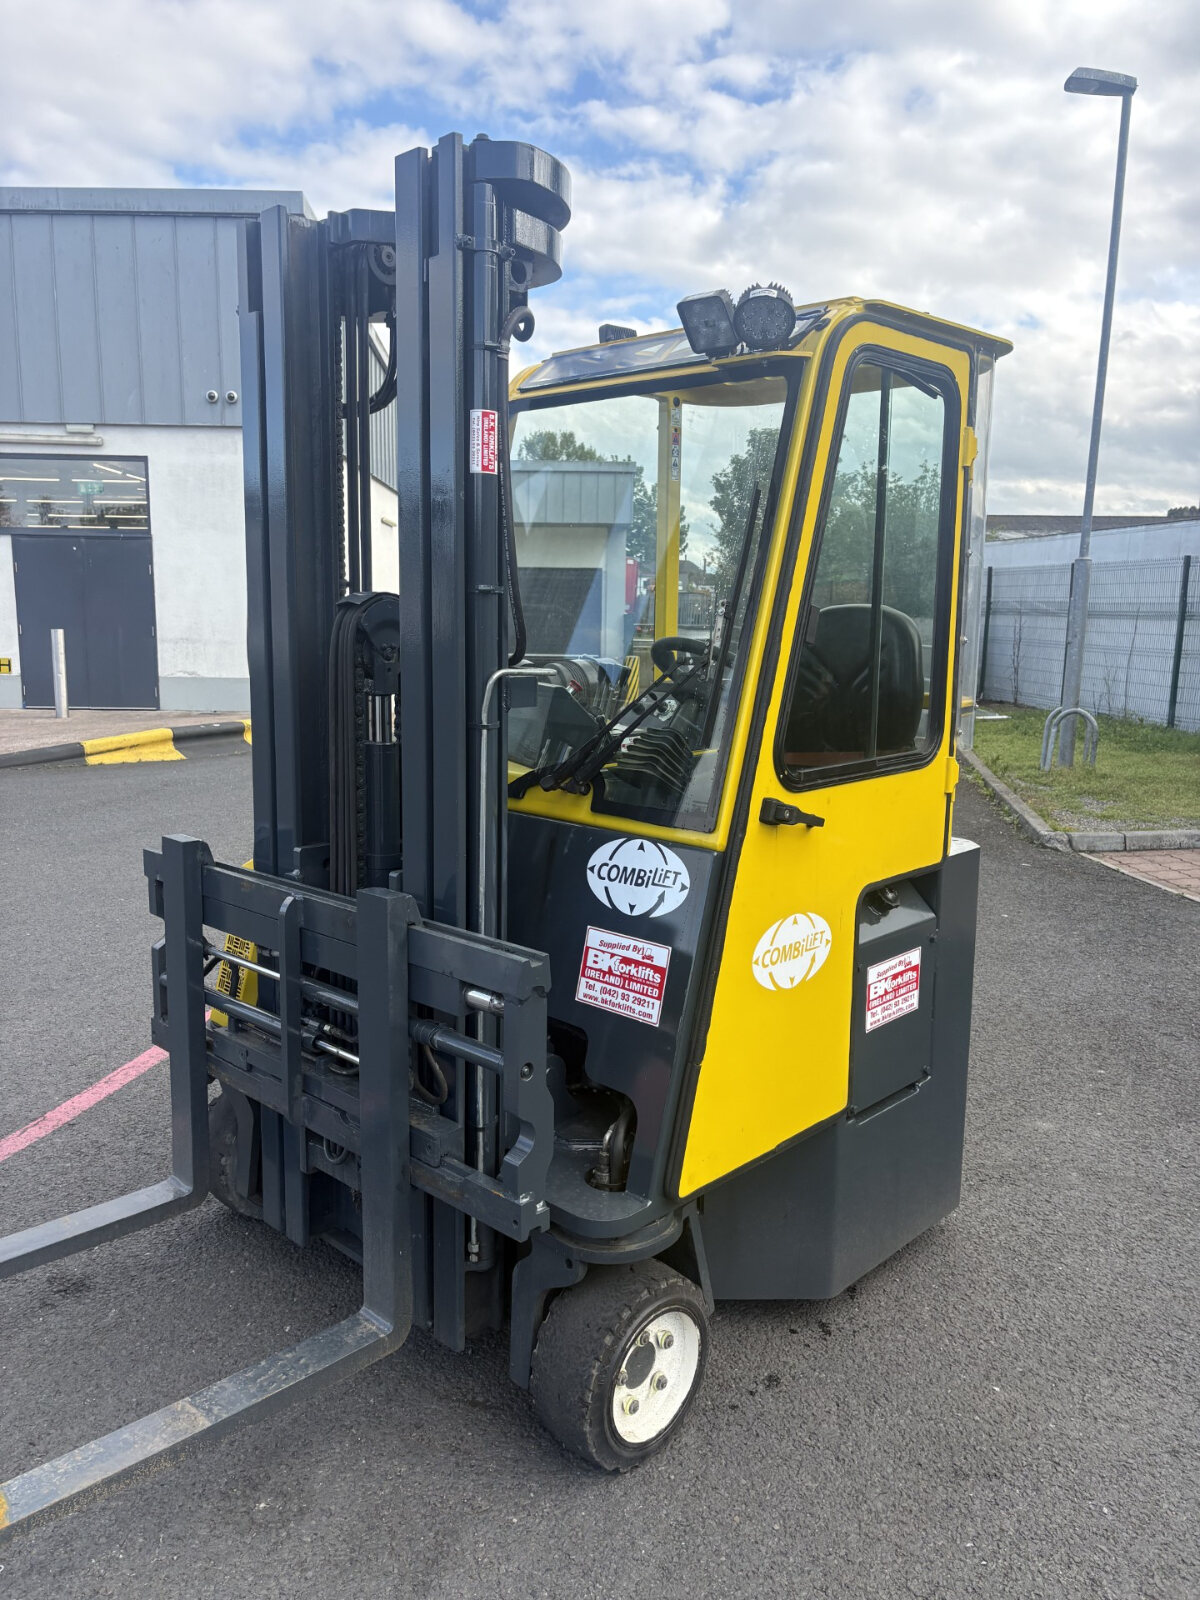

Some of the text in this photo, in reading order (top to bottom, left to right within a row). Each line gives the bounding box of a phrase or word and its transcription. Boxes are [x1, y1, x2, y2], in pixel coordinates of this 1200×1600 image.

[598, 940, 642, 955] Supplied By
[585, 967, 623, 988] (IRELAND)
[625, 980, 659, 997] LIMITED
[876, 964, 897, 979] Supplied
[584, 981, 655, 1010] Tel. (042) 93 29211
[896, 982, 916, 999] LIMITED
[583, 992, 653, 1019] www.bkforklifts.com
